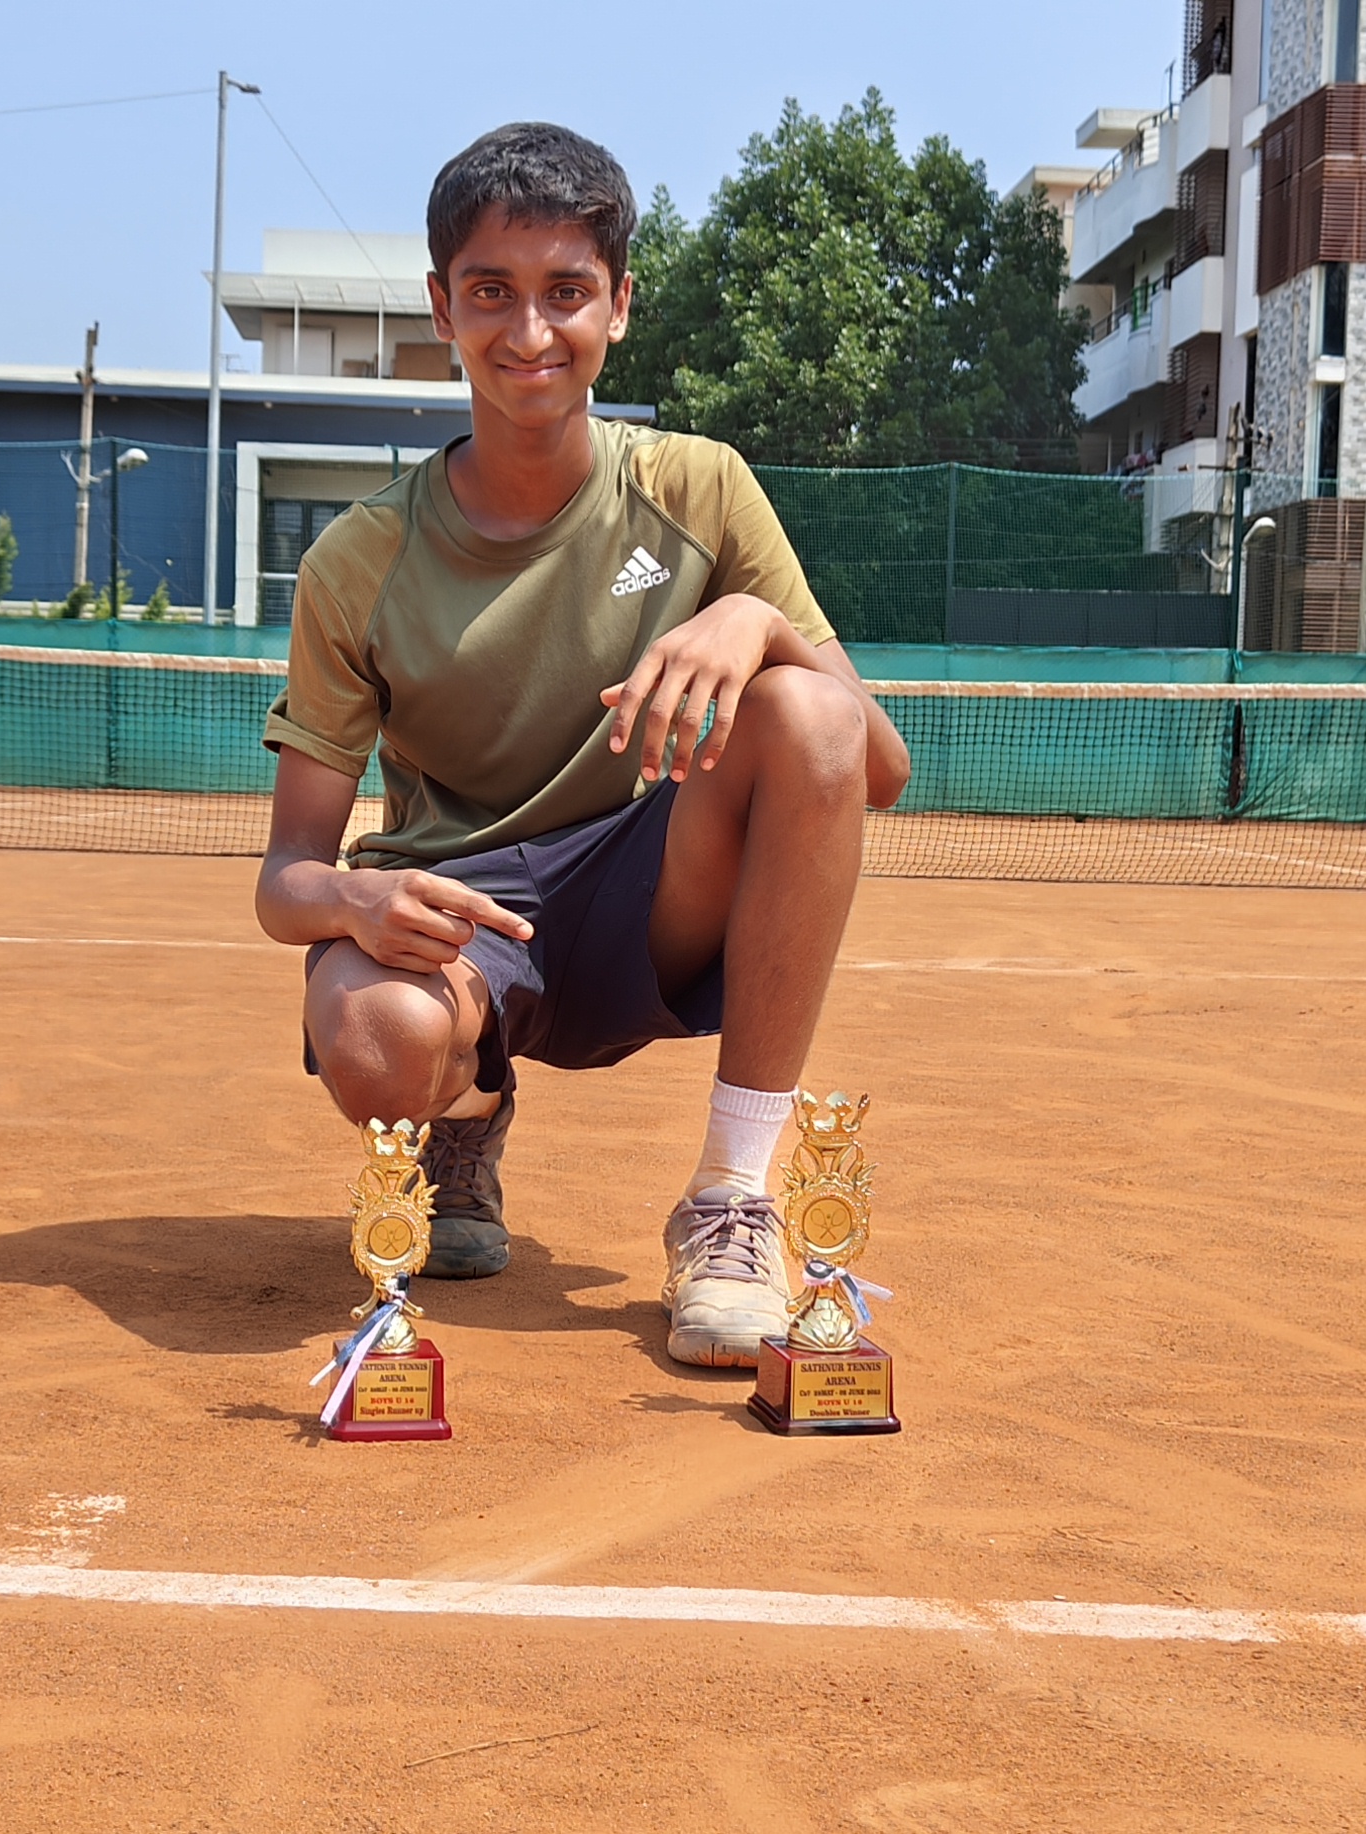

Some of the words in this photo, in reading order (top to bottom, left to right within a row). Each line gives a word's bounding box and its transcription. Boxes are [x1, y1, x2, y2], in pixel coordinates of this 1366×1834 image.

[610, 567, 671, 597] adidas
[398, 1363, 428, 1371] TENNIS
[800, 1362, 845, 1373] SATHNUR
[846, 1361, 882, 1372] TENNIS
[379, 1374, 407, 1382] ARENA
[825, 1375, 857, 1386] ARENA
[359, 1406, 385, 1417] Singles
[387, 1406, 413, 1415] Runner
[414, 1407, 424, 1417] up
[809, 1409, 841, 1417] Doubles
[842, 1408, 871, 1416] Winner
